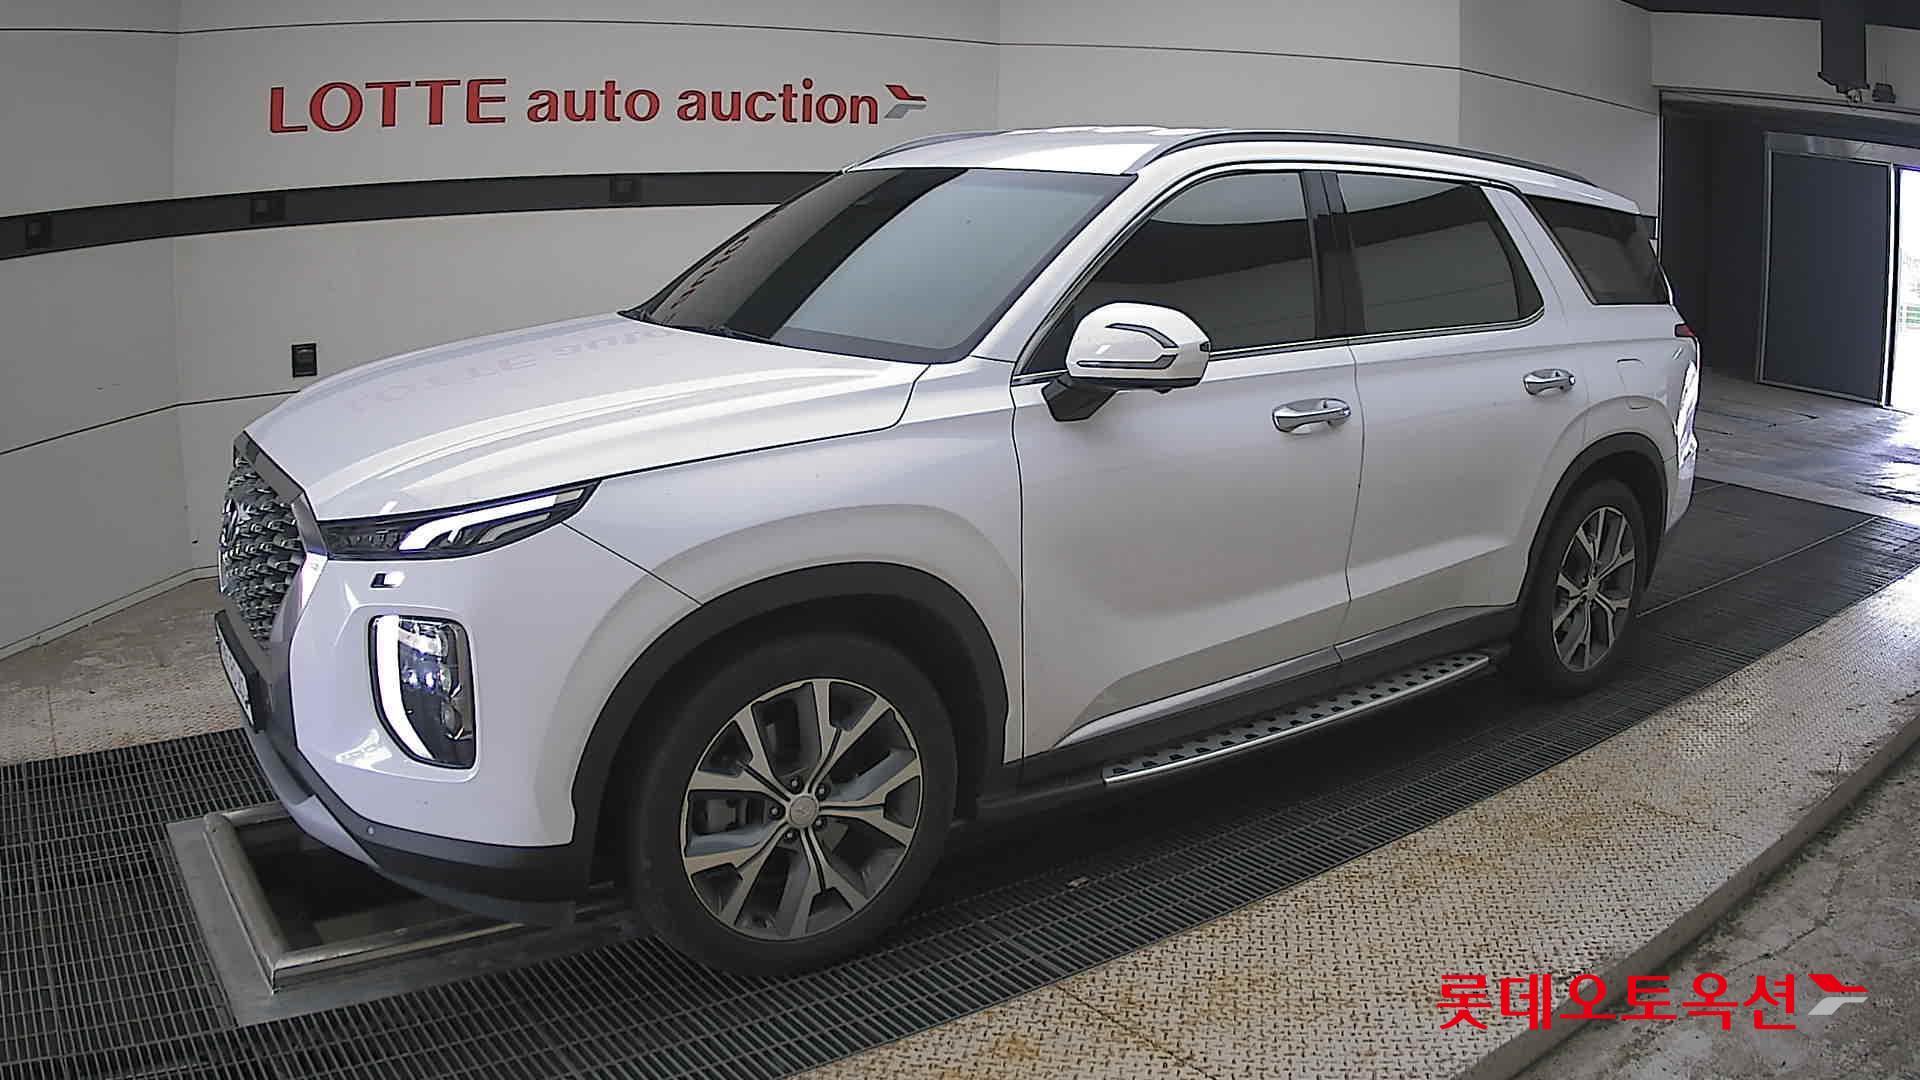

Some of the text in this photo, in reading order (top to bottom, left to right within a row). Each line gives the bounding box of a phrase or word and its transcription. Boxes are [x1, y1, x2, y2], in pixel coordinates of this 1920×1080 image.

[269, 79, 879, 133] LOTTE auto auction
